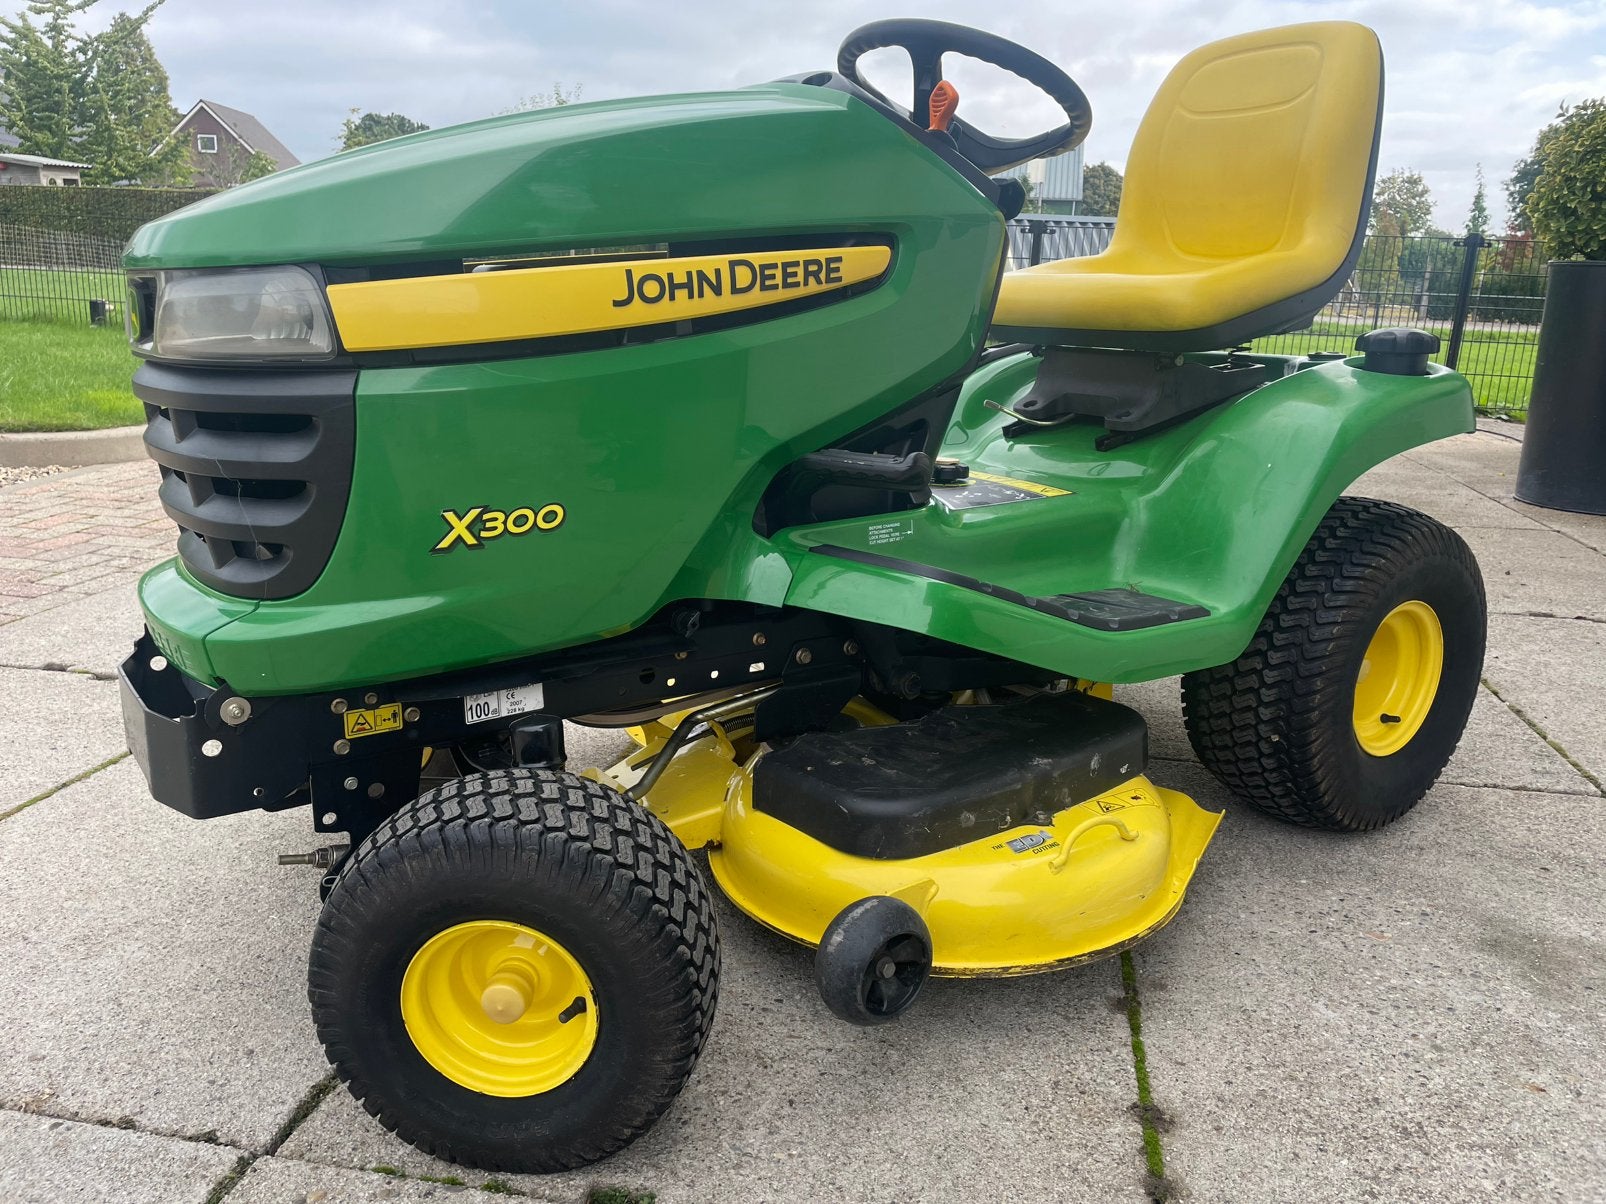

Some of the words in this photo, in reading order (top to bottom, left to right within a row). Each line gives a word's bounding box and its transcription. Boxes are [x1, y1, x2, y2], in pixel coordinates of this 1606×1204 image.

[612, 268, 722, 307] JOHN
[728, 256, 843, 295] DEERE
[430, 503, 566, 553] X300
[468, 702, 490, 719] 100
[991, 843, 1005, 851] THE
[1032, 841, 1060, 855] CUTTING
